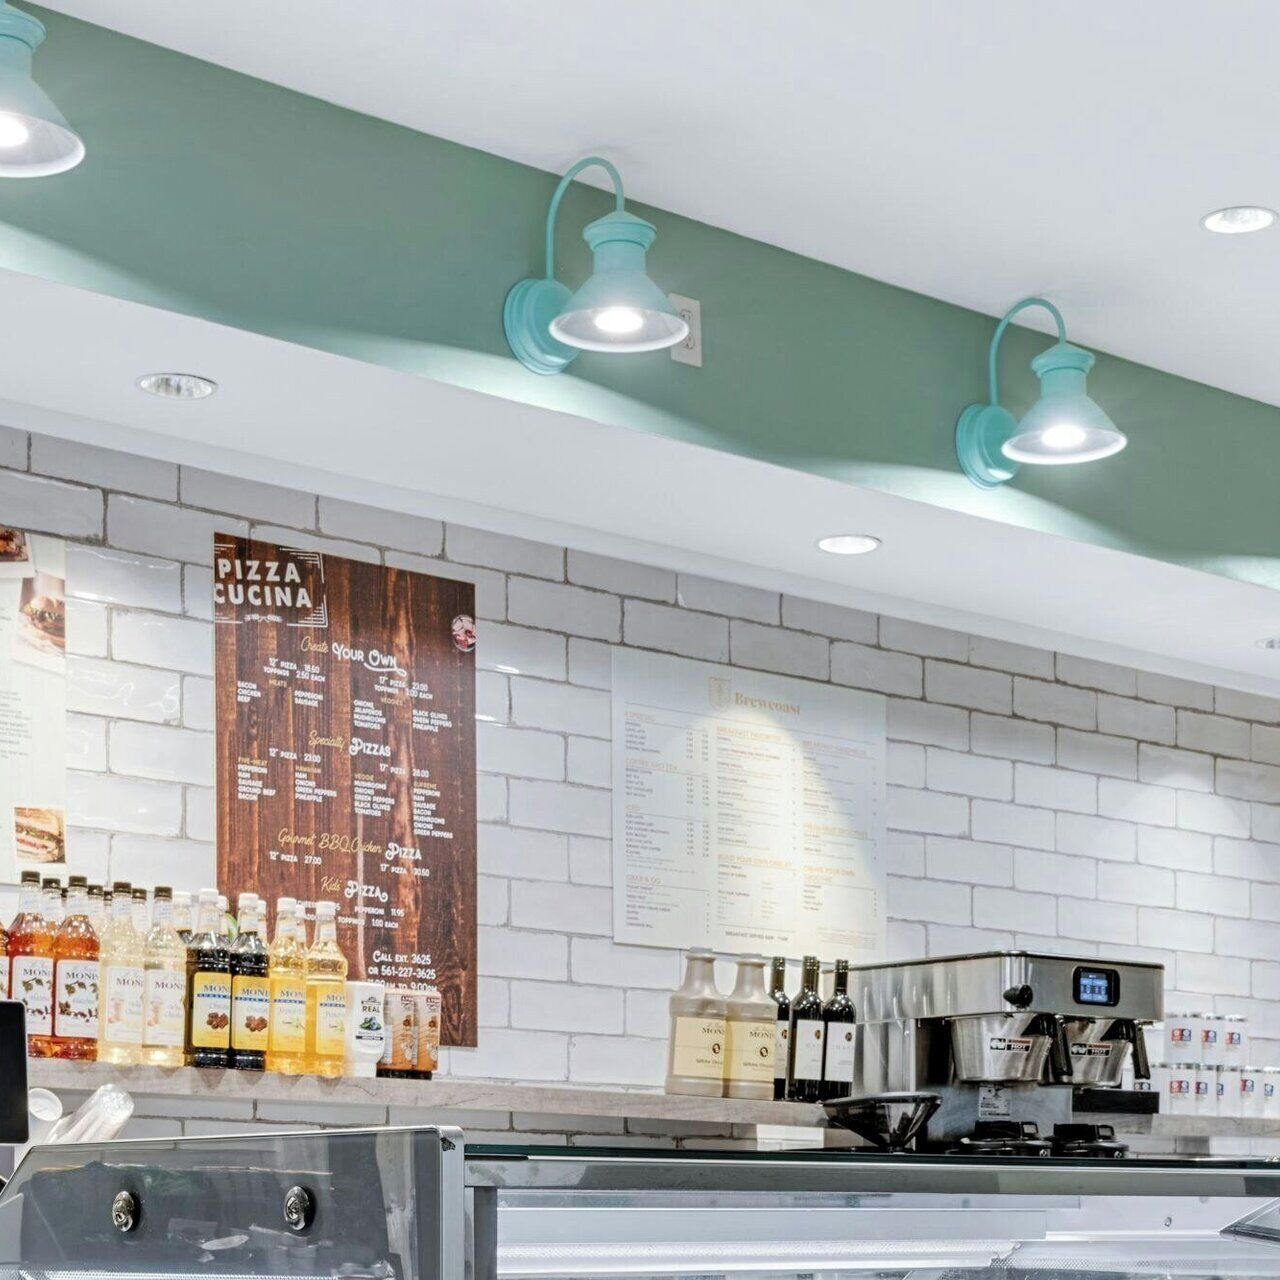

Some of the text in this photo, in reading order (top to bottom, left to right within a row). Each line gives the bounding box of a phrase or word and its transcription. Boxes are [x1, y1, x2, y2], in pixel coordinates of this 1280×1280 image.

[218, 558, 301, 583] PIZZA
[214, 584, 313, 608] CUCINA
[301, 636, 329, 654] Create
[735, 691, 801, 716] Brewcoast
[308, 729, 392, 757] Specialty PIZZAS
[278, 828, 422, 861] Gourmet BBQ Chicken PIZZA
[344, 880, 389, 902] PIZZA
[373, 950, 392, 963] CALL
[412, 953, 432, 965] 3625
[368, 966, 437, 980] OR 561-227-3625
[362, 1005, 380, 1013] REAL
